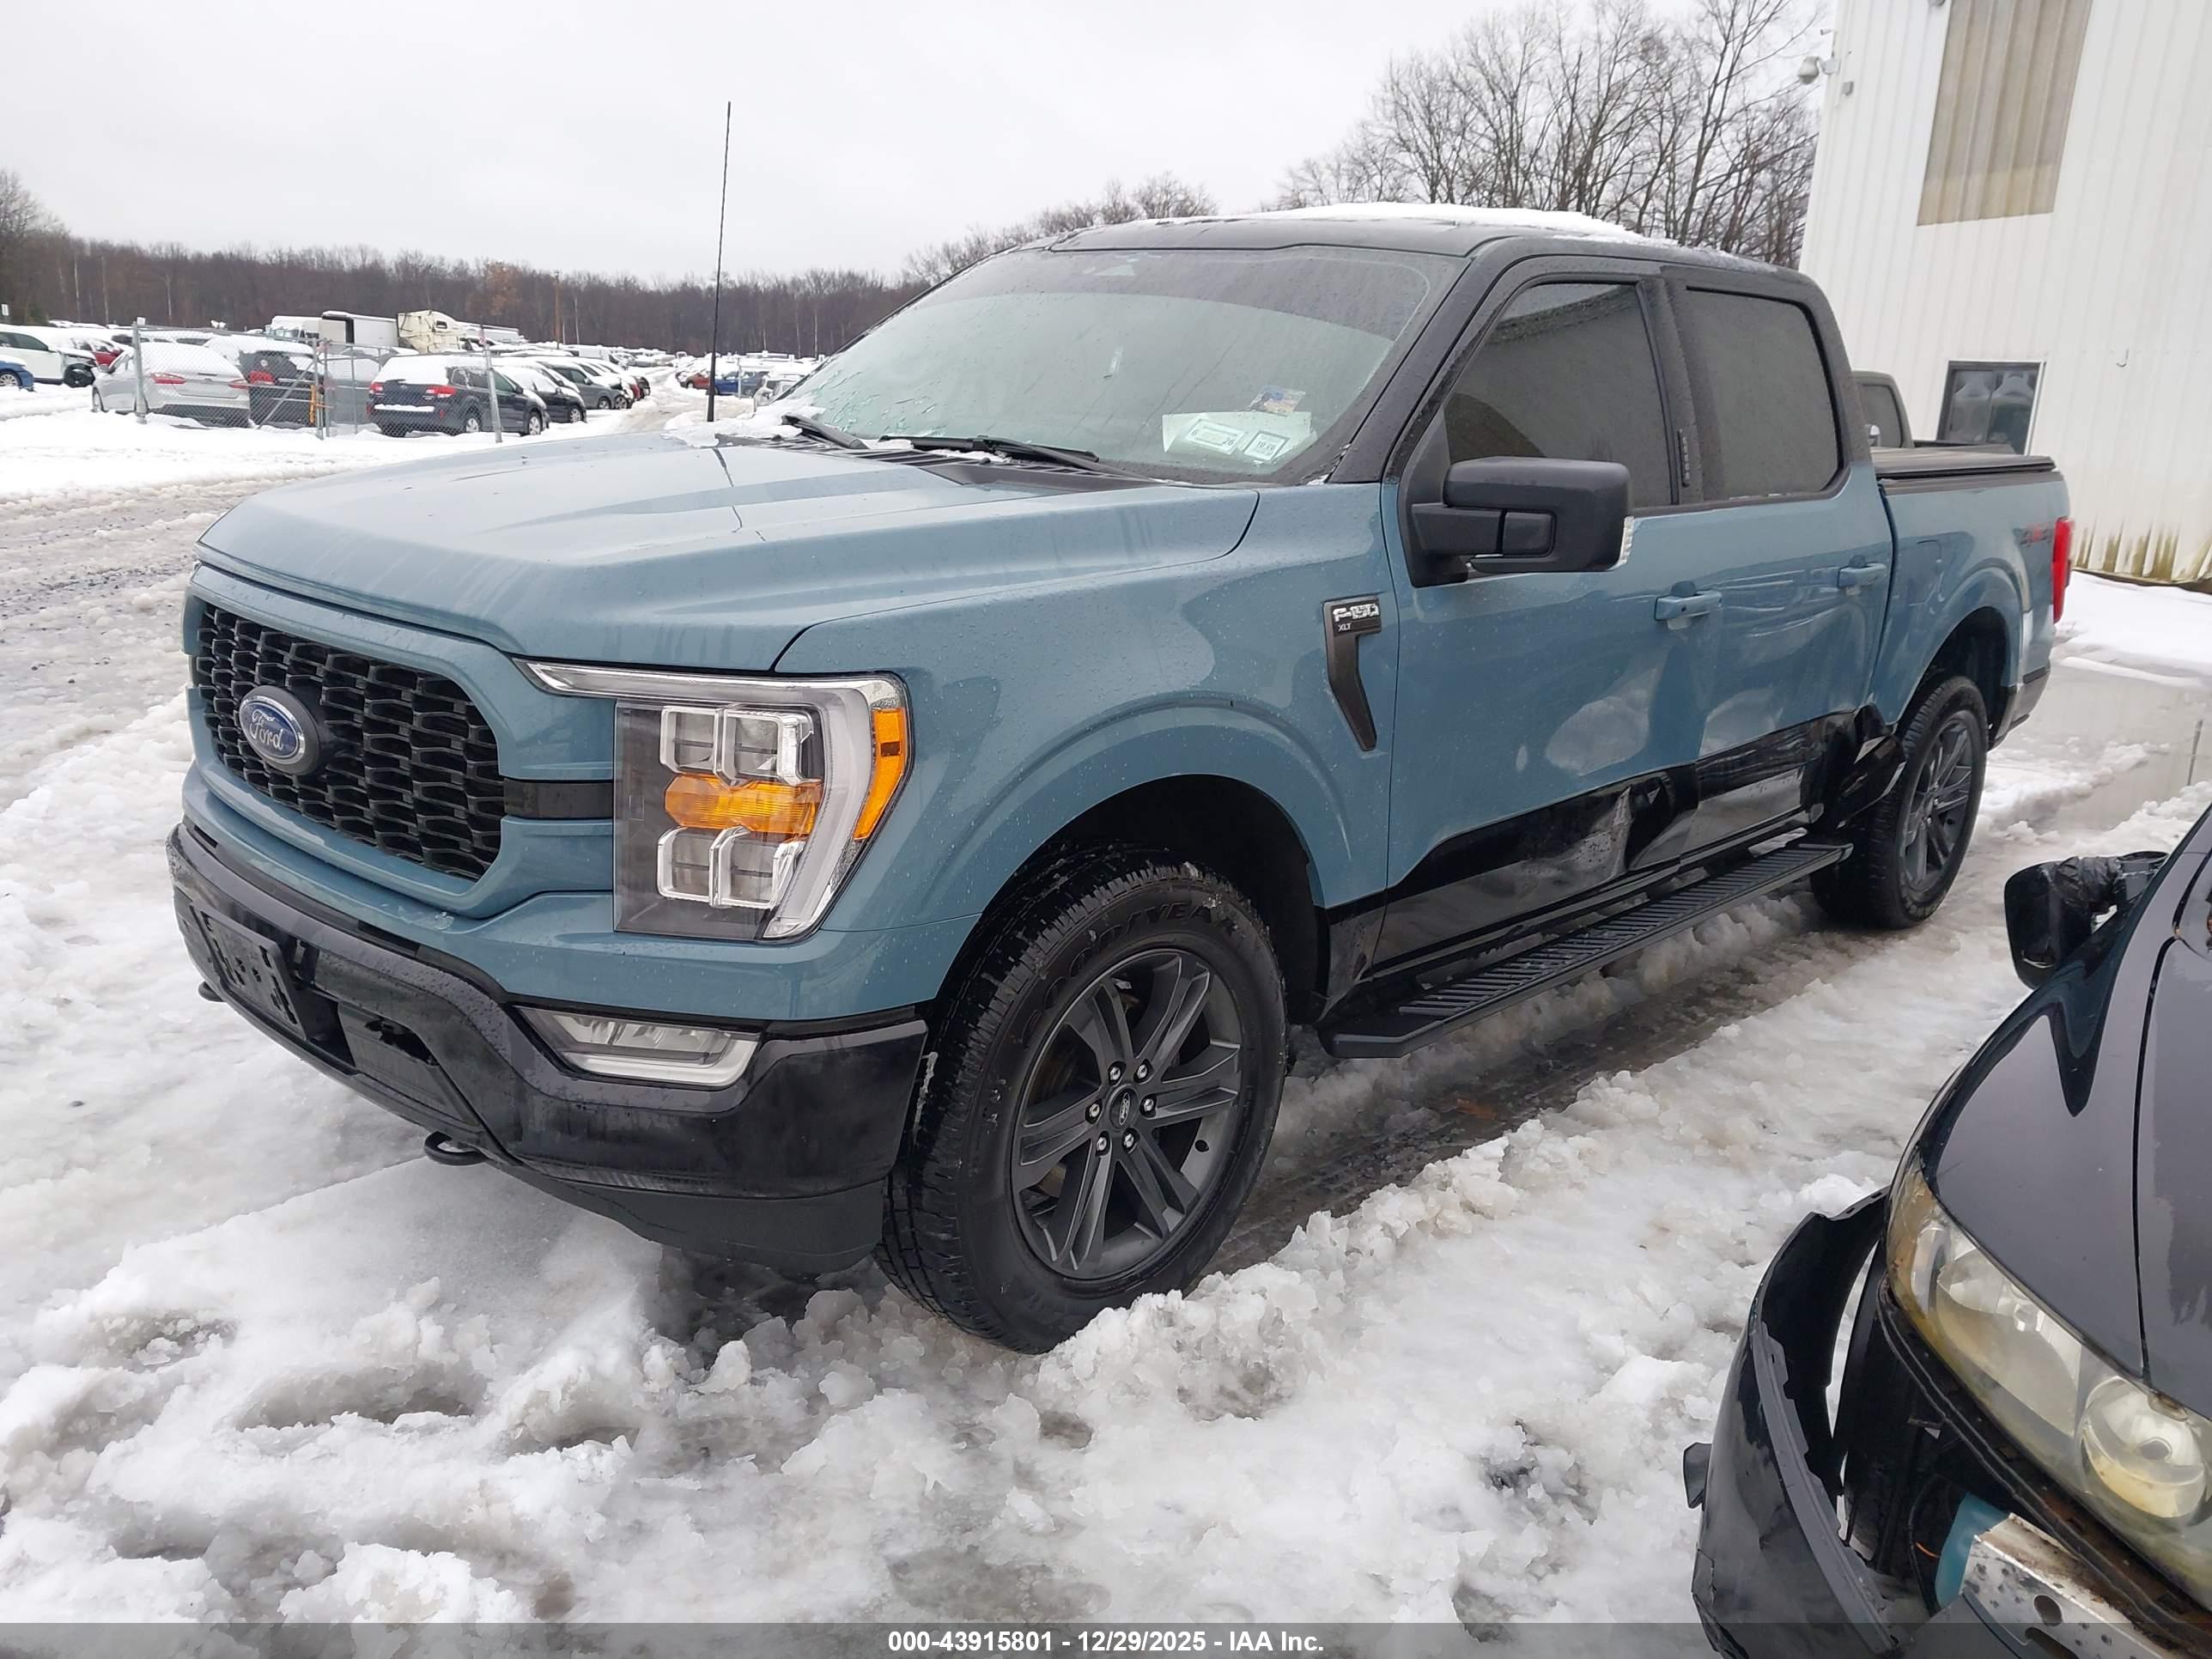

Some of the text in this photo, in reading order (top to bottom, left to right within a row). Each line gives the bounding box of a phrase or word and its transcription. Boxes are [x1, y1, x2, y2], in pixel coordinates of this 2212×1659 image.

[1332, 603, 1380, 623] F-150
[1338, 623, 1352, 632] XLT
[249, 708, 283, 750] Ford
